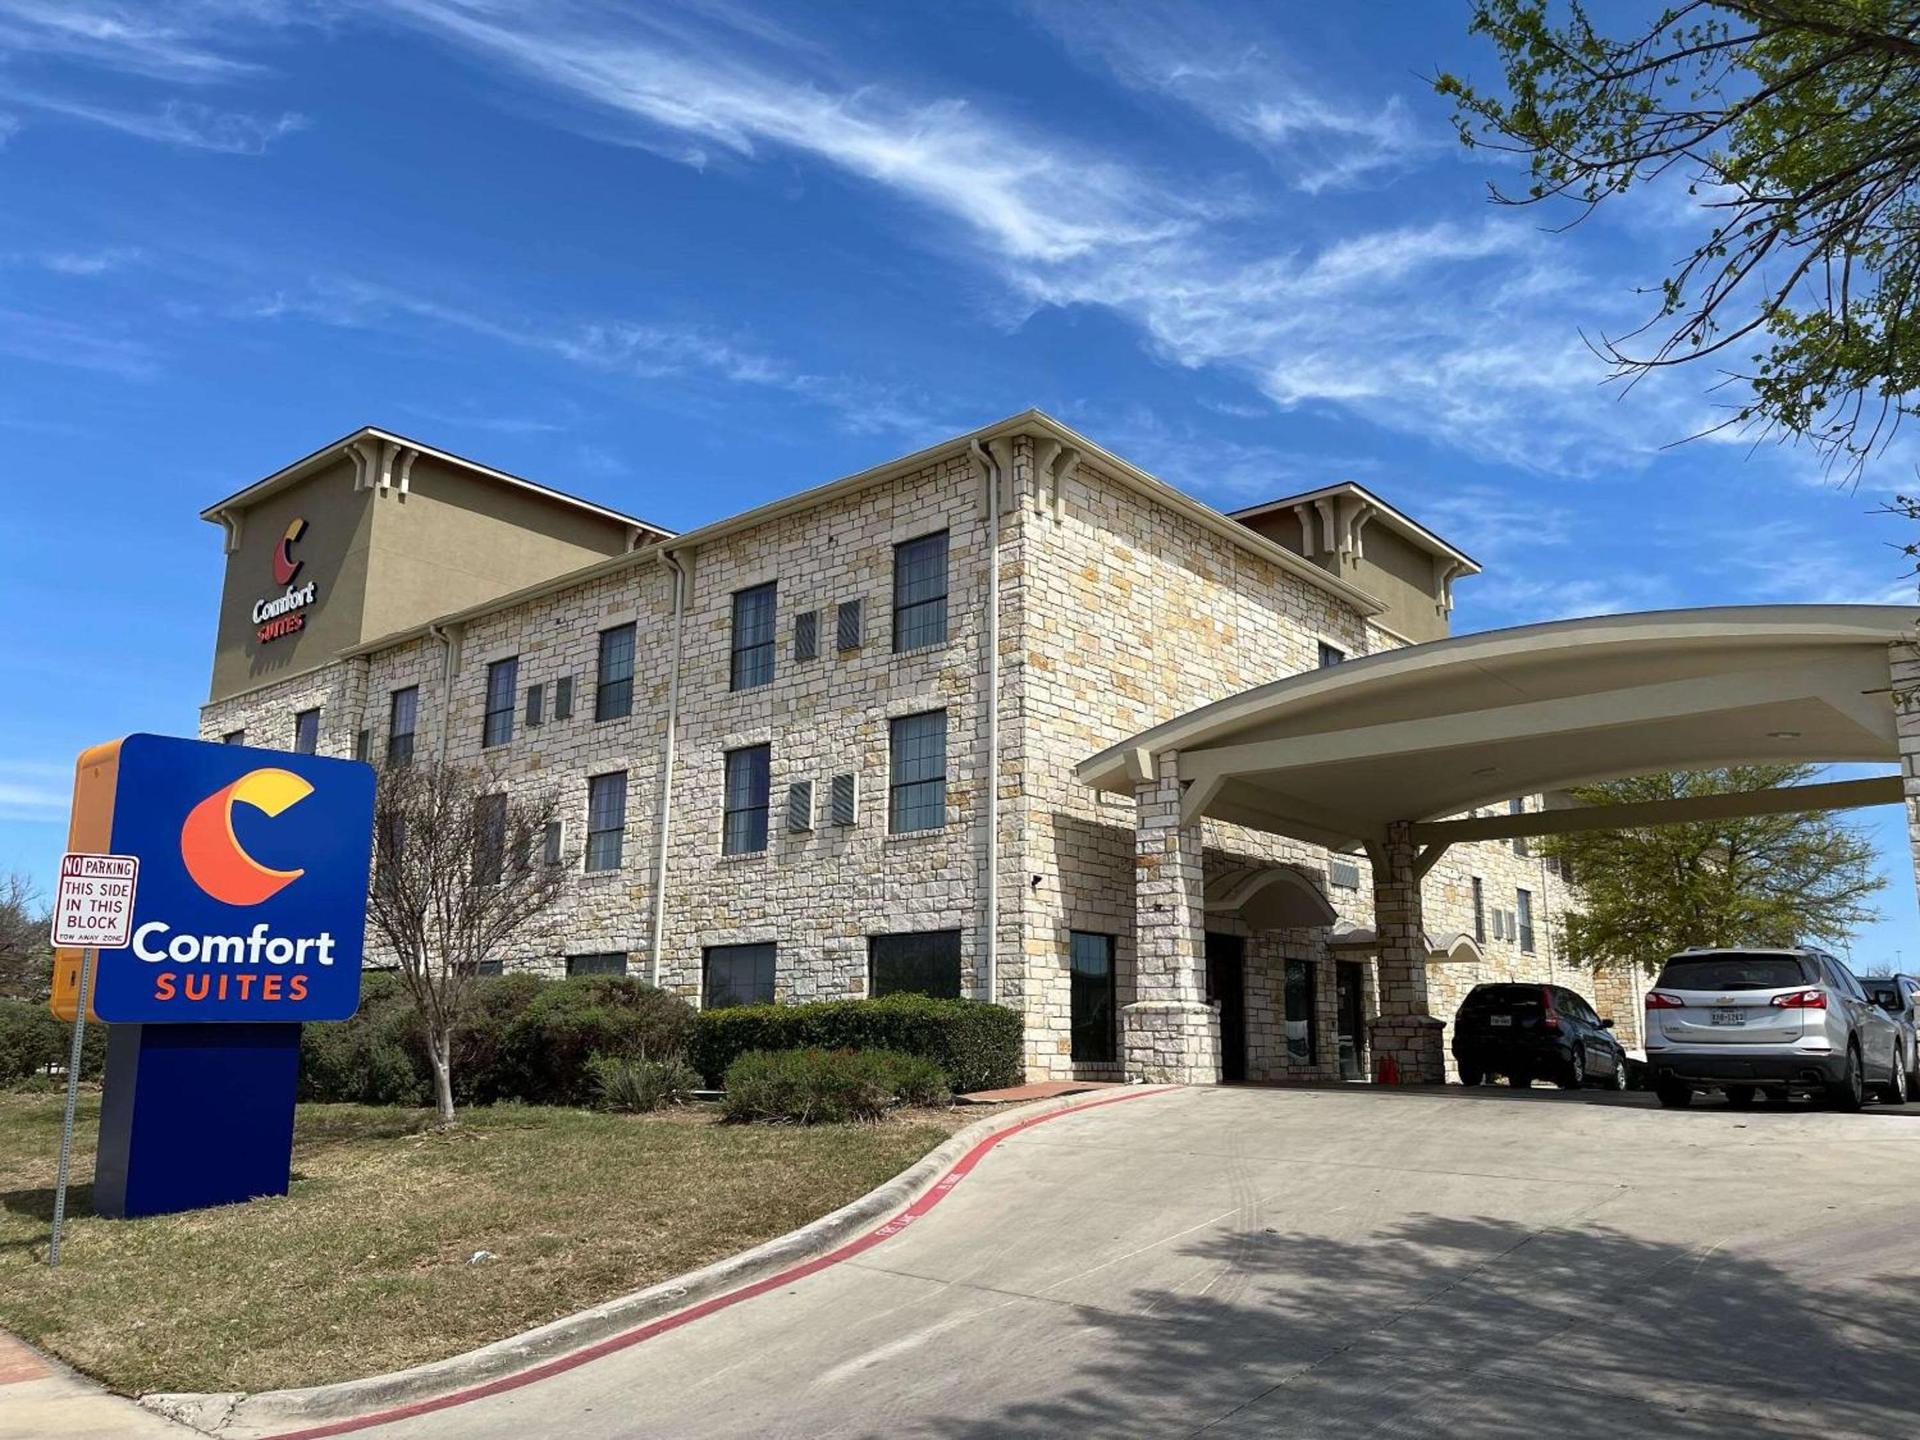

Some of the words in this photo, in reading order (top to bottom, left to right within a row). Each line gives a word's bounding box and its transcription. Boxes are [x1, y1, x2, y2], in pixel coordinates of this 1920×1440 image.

[253, 581, 315, 624] Comfort
[257, 614, 303, 642] SUITES
[63, 857, 81, 875] NO
[85, 860, 131, 876] PARKING
[65, 881, 94, 896] THIS
[99, 883, 130, 897] SIDE
[65, 898, 82, 912] IN
[89, 899, 123, 914] THIS
[67, 915, 118, 929] BLOCK
[102, 934, 123, 942] ZONE
[132, 921, 336, 966] Comfort
[154, 972, 309, 1001] SUITES
